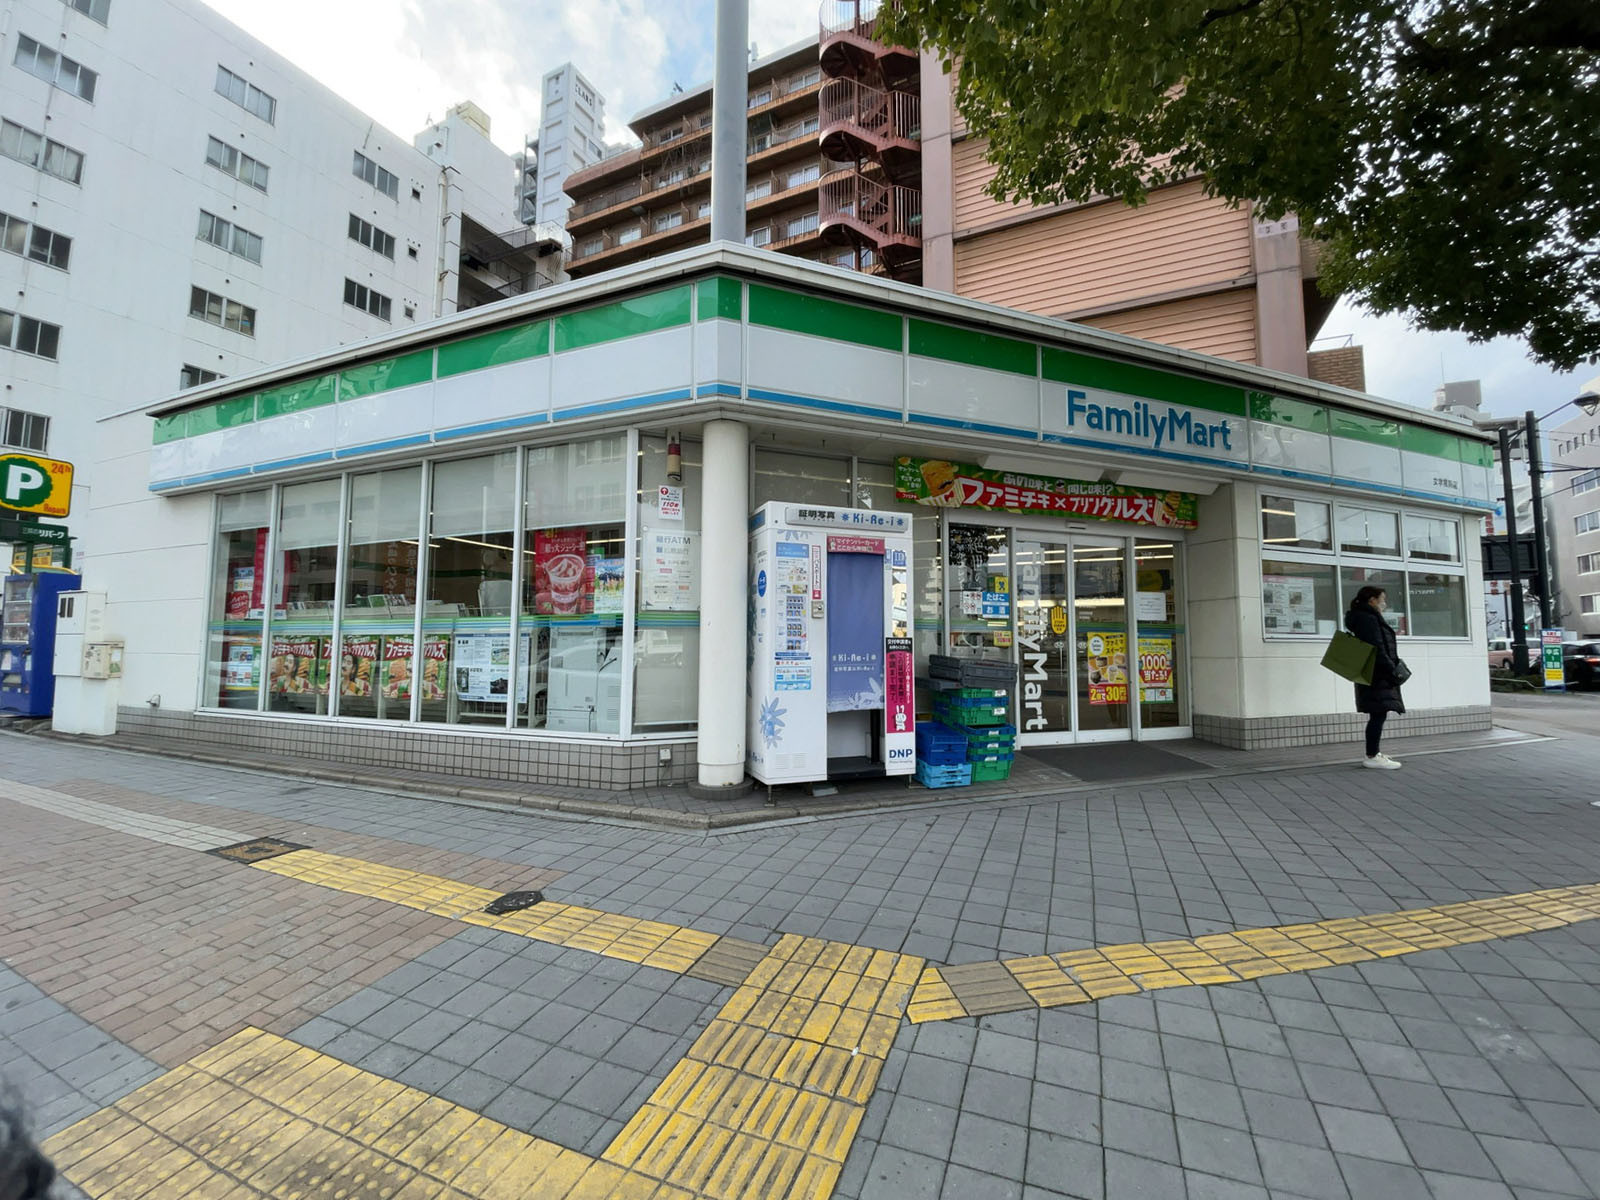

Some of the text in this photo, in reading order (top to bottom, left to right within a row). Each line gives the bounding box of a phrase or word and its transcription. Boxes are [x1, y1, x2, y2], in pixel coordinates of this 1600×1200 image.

[1067, 389, 1231, 450] FamilyMart
[5, 464, 44, 501] P
[1003, 473, 1054, 493] あの味と
[799, 509, 836, 519] 証明写真
[853, 513, 895, 526] Ki-Re-i
[986, 593, 1006, 602] たばこ
[889, 749, 913, 758] DNP
